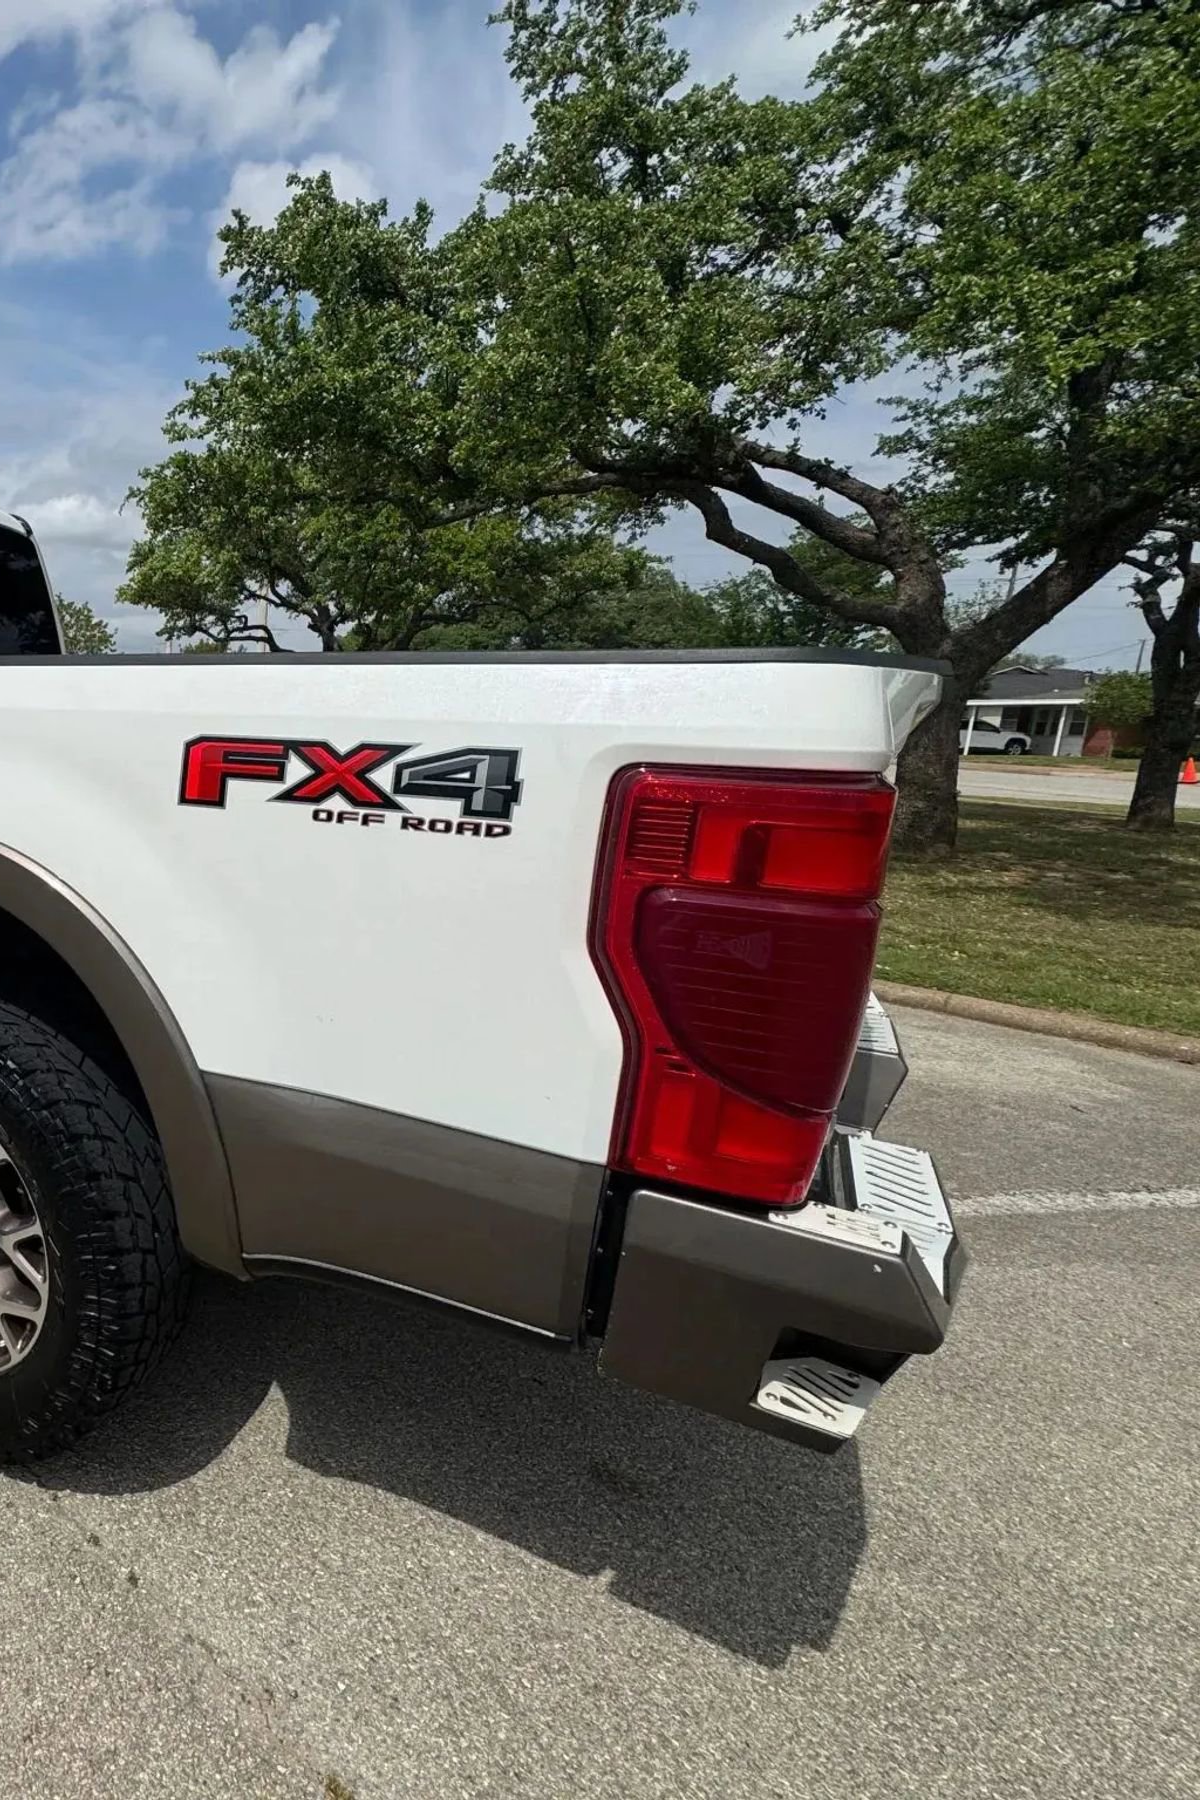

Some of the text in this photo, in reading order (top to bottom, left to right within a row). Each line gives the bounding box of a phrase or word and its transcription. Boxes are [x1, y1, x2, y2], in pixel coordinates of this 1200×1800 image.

[177, 734, 523, 822] FX4
[311, 808, 513, 838] OFF ROAD
